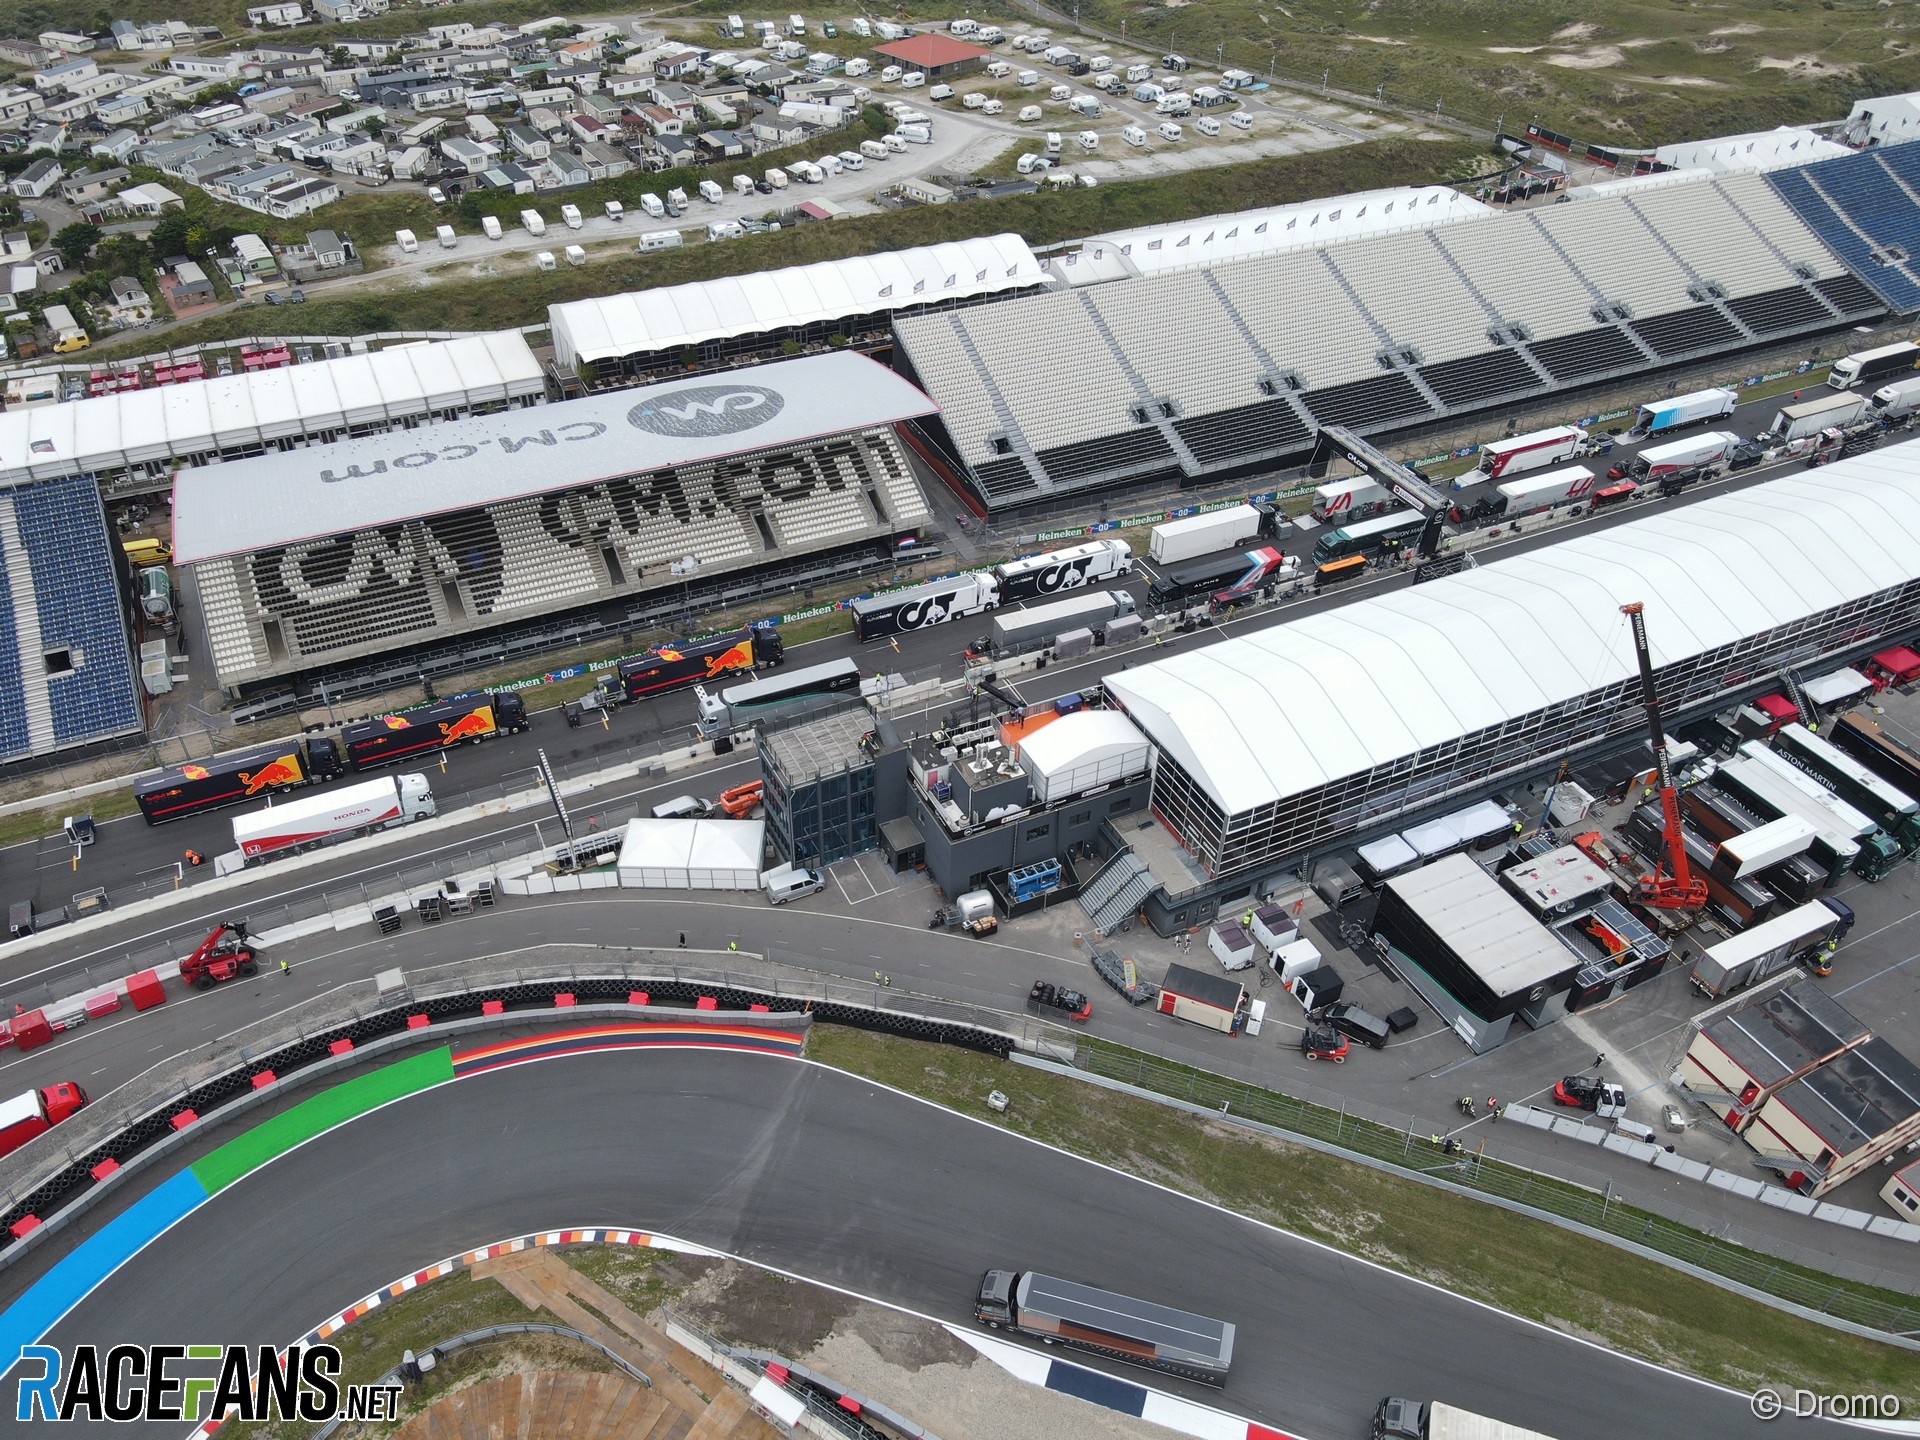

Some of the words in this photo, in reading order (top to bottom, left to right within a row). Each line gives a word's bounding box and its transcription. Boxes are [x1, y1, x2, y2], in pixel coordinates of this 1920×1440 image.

[1276, 485, 1315, 500] Heineken
[1200, 500, 1240, 514] Heineken
[1121, 513, 1163, 528] Heineken
[1038, 528, 1082, 542] Heineken
[1193, 578, 1220, 589] ALPINE
[783, 605, 832, 624] Heineken
[483, 677, 541, 696] Heineken
[1658, 748, 1672, 788] PEINEMANN
[1776, 748, 1805, 770] ASTON
[1804, 765, 1837, 791] MARTIN
[333, 807, 371, 821] HONDA
[1669, 796, 1682, 837] PEINEMANN
